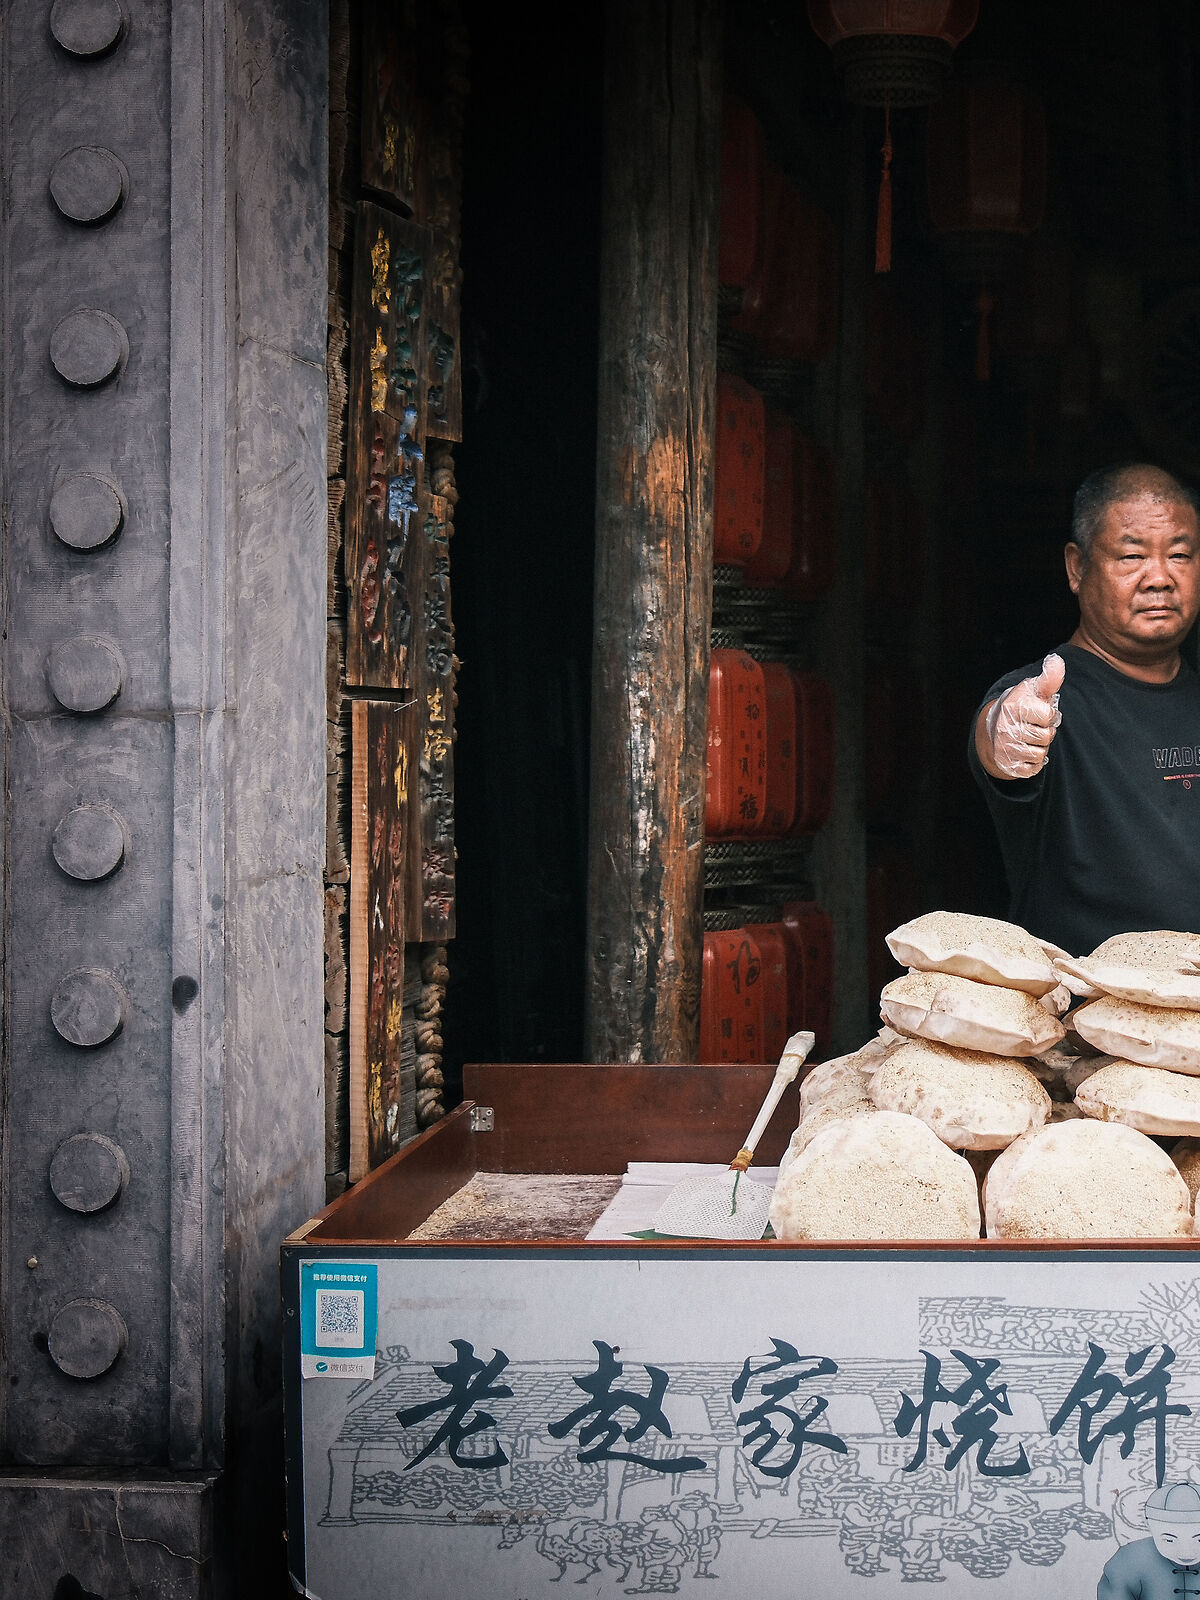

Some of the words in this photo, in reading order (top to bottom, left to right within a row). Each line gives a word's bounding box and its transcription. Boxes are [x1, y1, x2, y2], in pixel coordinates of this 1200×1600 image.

[330, 1363, 363, 1373] 微信支付
[397, 1336, 1192, 1484] 老赵家烧饼
